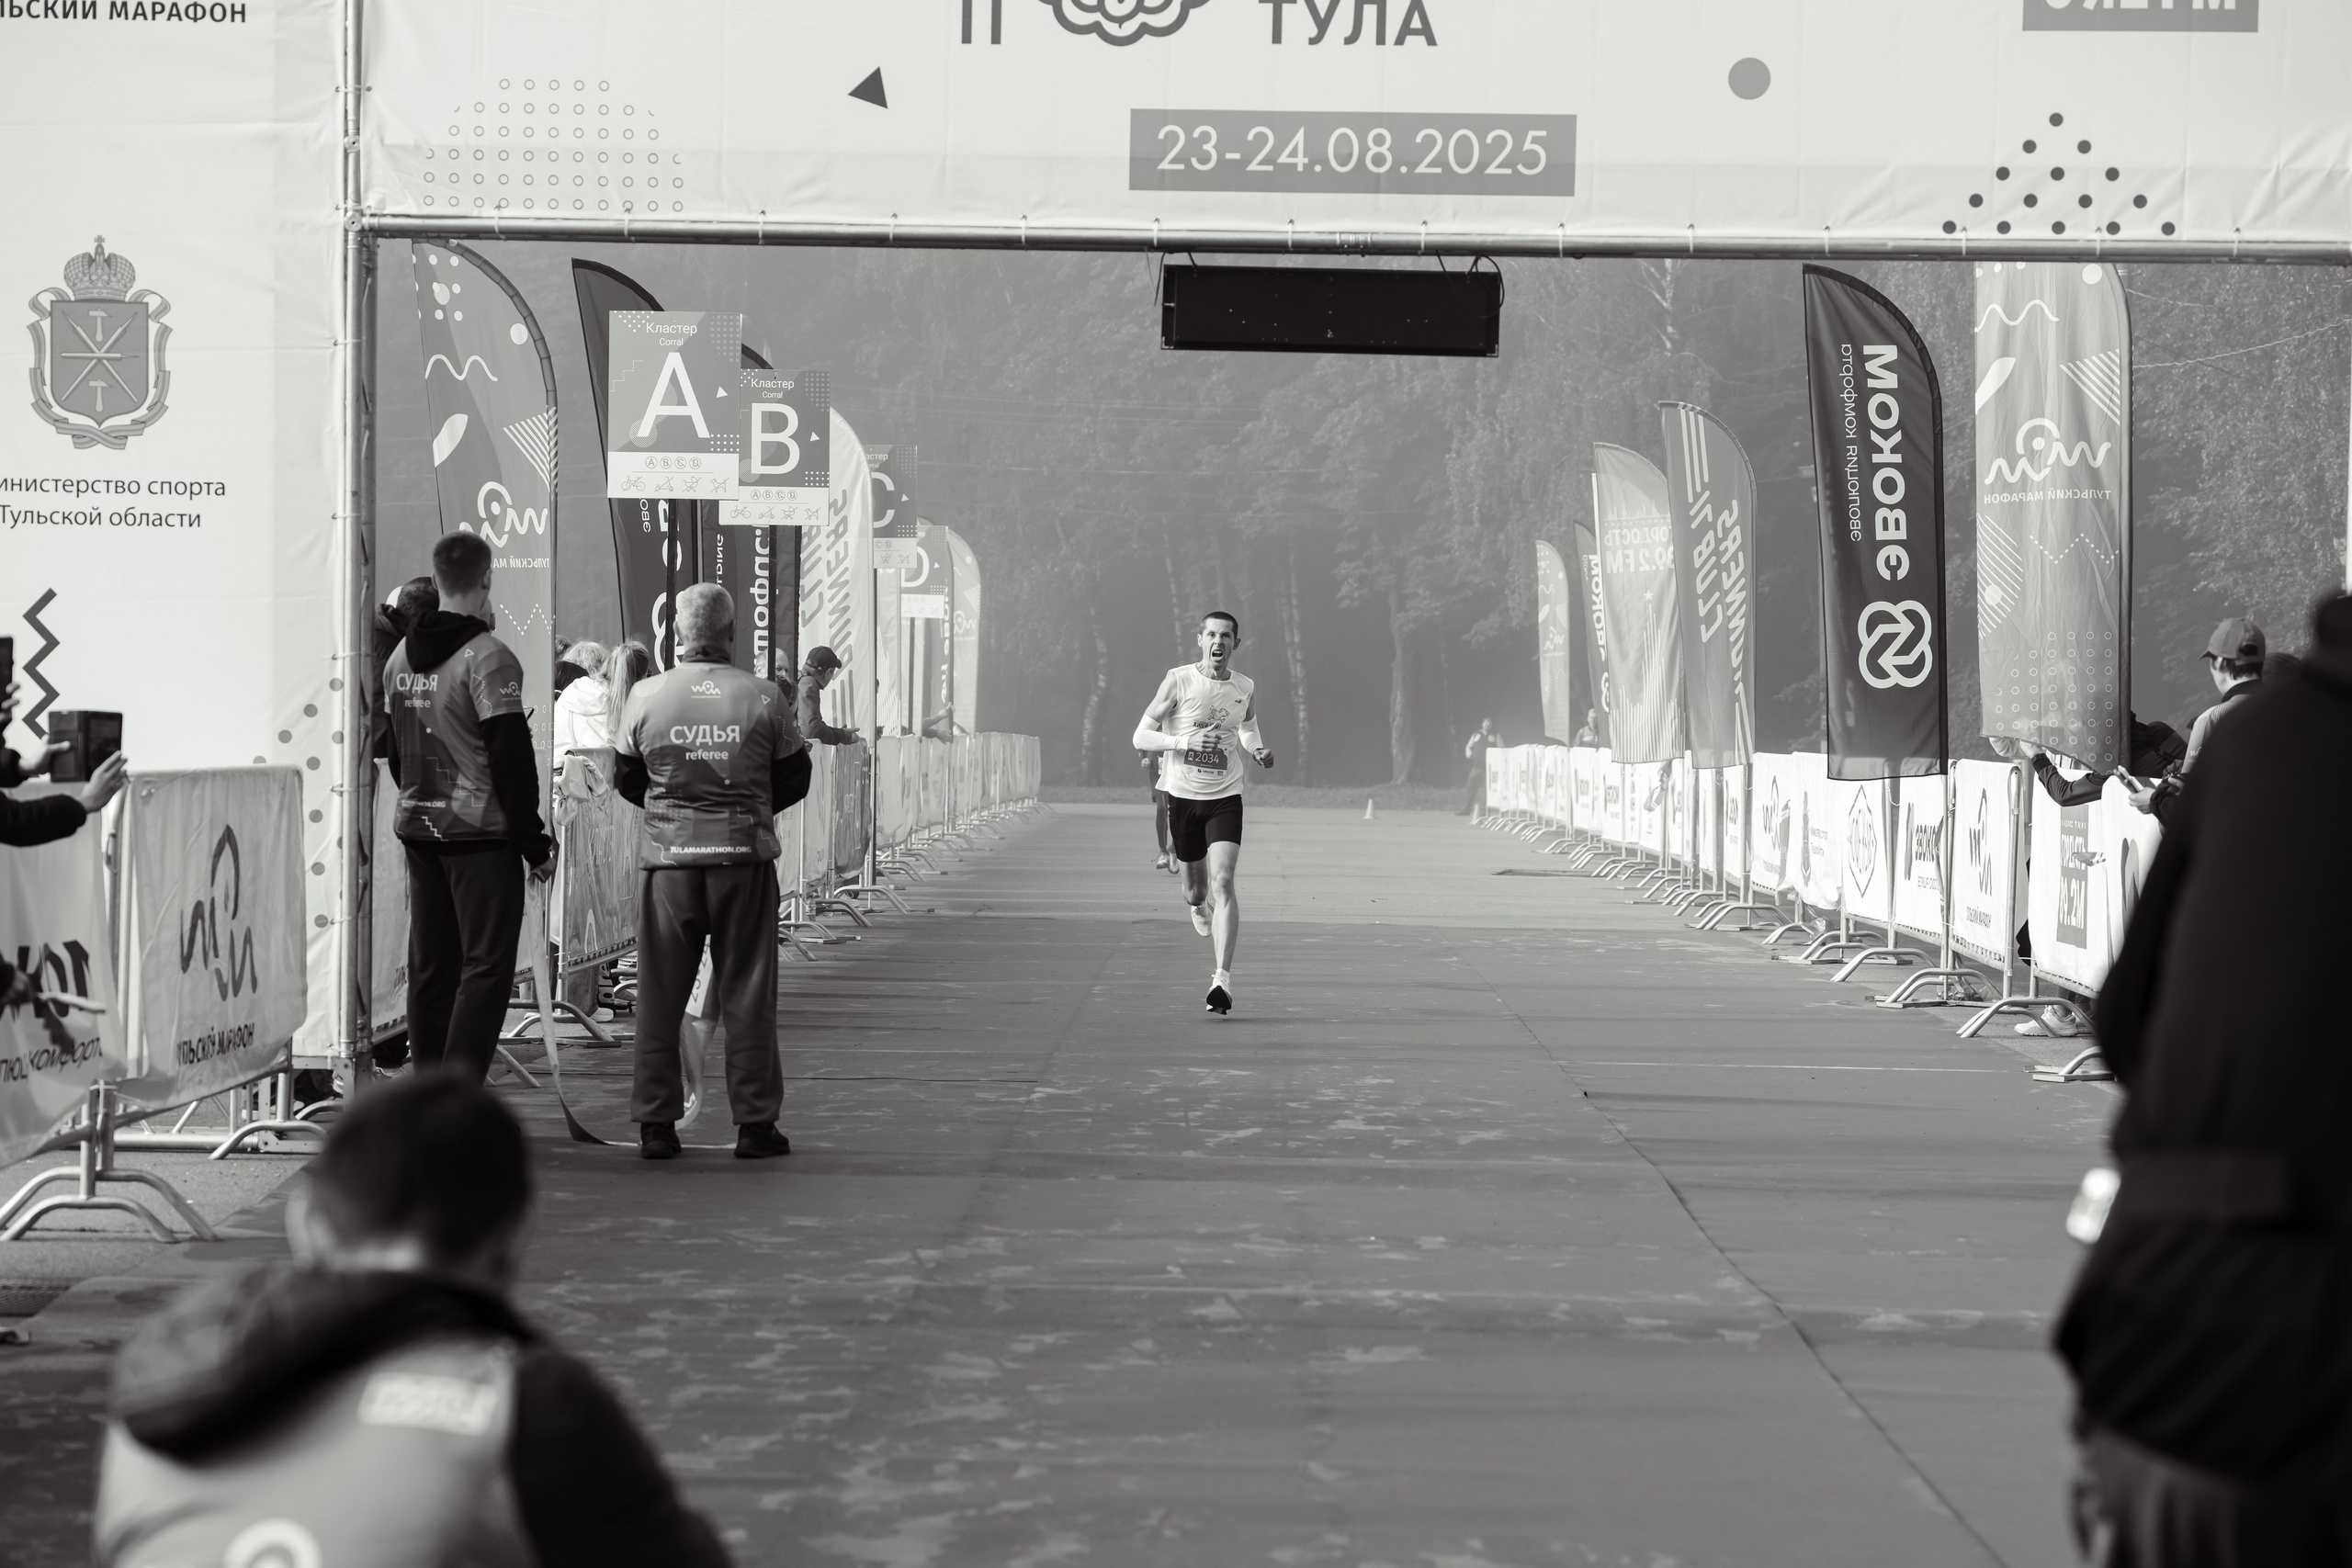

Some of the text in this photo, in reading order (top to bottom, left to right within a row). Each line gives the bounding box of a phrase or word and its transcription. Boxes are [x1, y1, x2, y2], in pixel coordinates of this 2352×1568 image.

[108, 1, 246, 23] МАРАФОН
[1259, 0, 1438, 46] ТУЛА
[1156, 124, 1549, 176] 23-24.08.2025
[646, 321, 697, 336] Кластер
[659, 337, 684, 346] Corral
[751, 378, 795, 390] Кластер
[637, 352, 710, 438] A
[751, 402, 800, 475] B
[865, 453, 888, 462] астер
[0, 476, 226, 501] инистерство спорта
[0, 504, 201, 528] Тульской области
[396, 673, 438, 694] СУДЬЯ
[669, 725, 741, 746] СУДЬЯ
[685, 750, 729, 761] referee
[1194, 752, 1219, 764] 2034
[670, 846, 752, 854] TULAMARATHON.ORG
